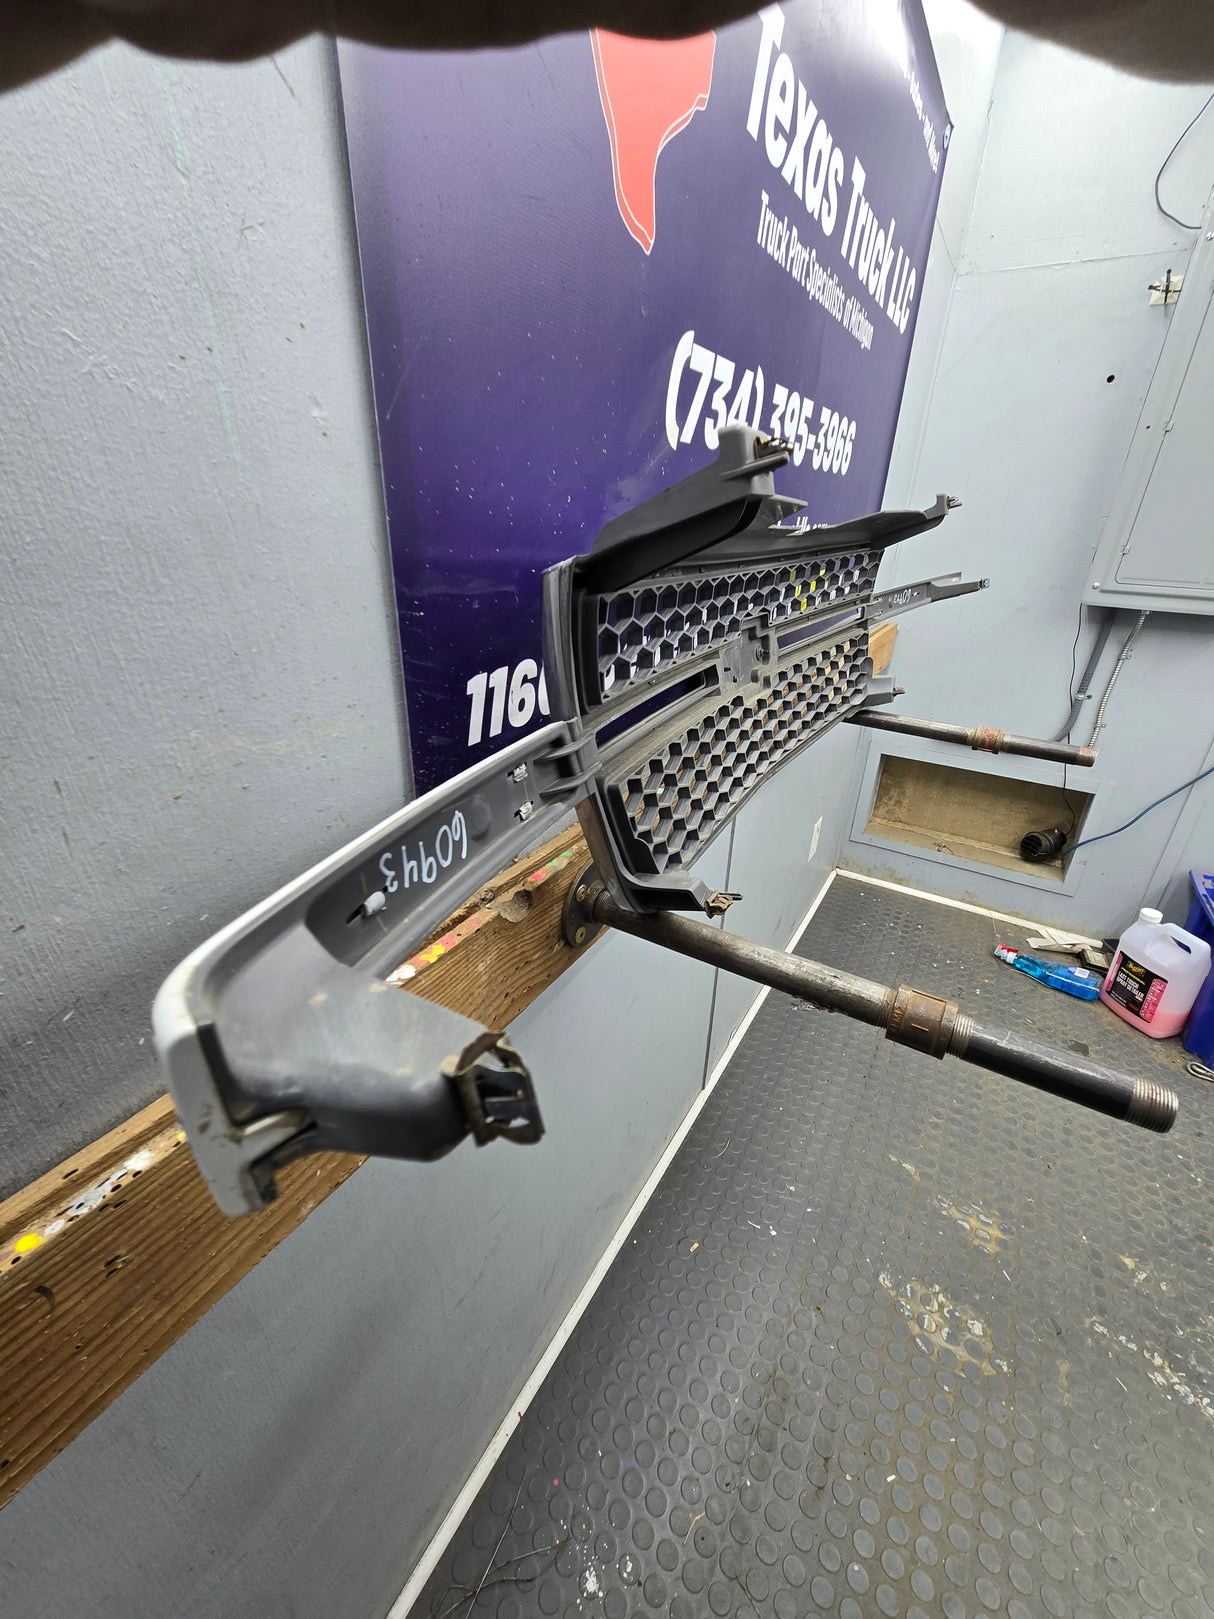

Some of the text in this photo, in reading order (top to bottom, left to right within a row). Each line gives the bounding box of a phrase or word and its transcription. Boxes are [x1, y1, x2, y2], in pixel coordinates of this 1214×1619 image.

[747, 3, 916, 334] Texas Truck LLC
[757, 189, 790, 268] Truck
[786, 225, 809, 287] Part
[806, 248, 845, 322] Specialists
[843, 296, 855, 331] of
[665, 330, 857, 476] (734) 395-3966
[379, 810, 468, 893] 60943
